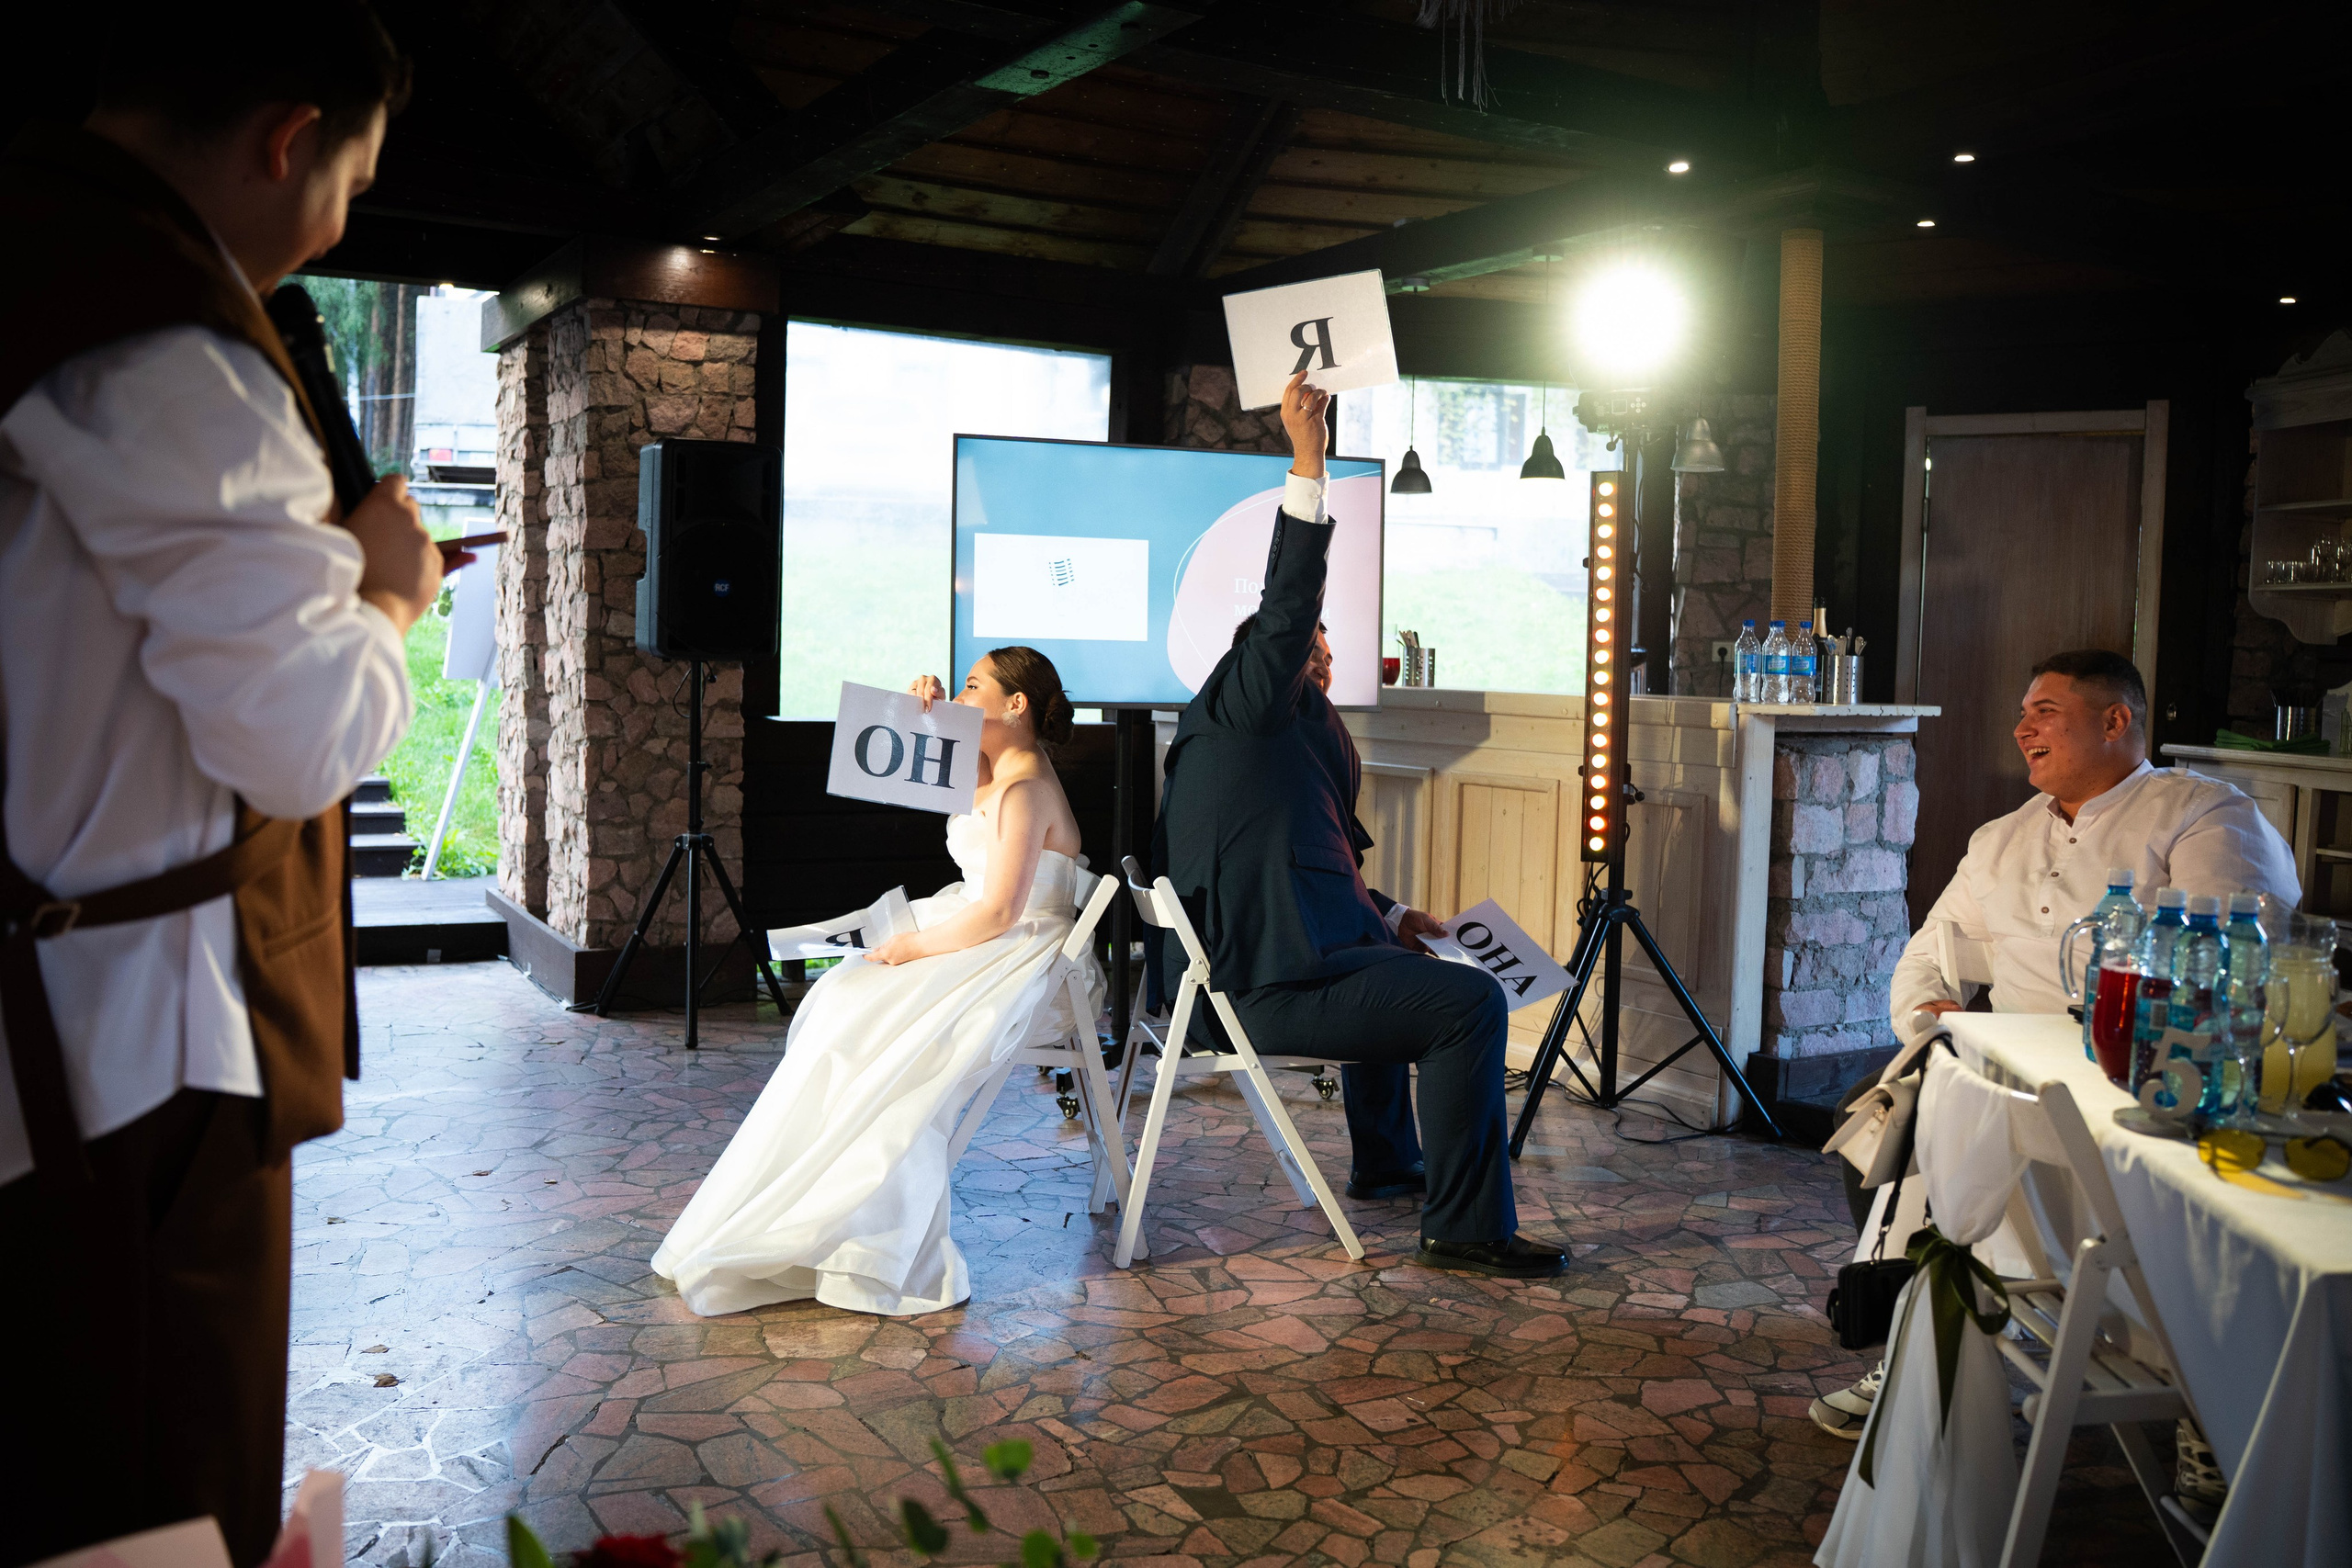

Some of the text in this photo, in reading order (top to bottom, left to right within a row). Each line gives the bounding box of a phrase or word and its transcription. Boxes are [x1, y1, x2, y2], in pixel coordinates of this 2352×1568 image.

[1289, 317, 1342, 376] Я
[715, 583, 729, 592] RCF
[854, 725, 961, 790] ОН
[1456, 921, 1538, 998] ОНА
[2139, 1027, 2212, 1118] 5
